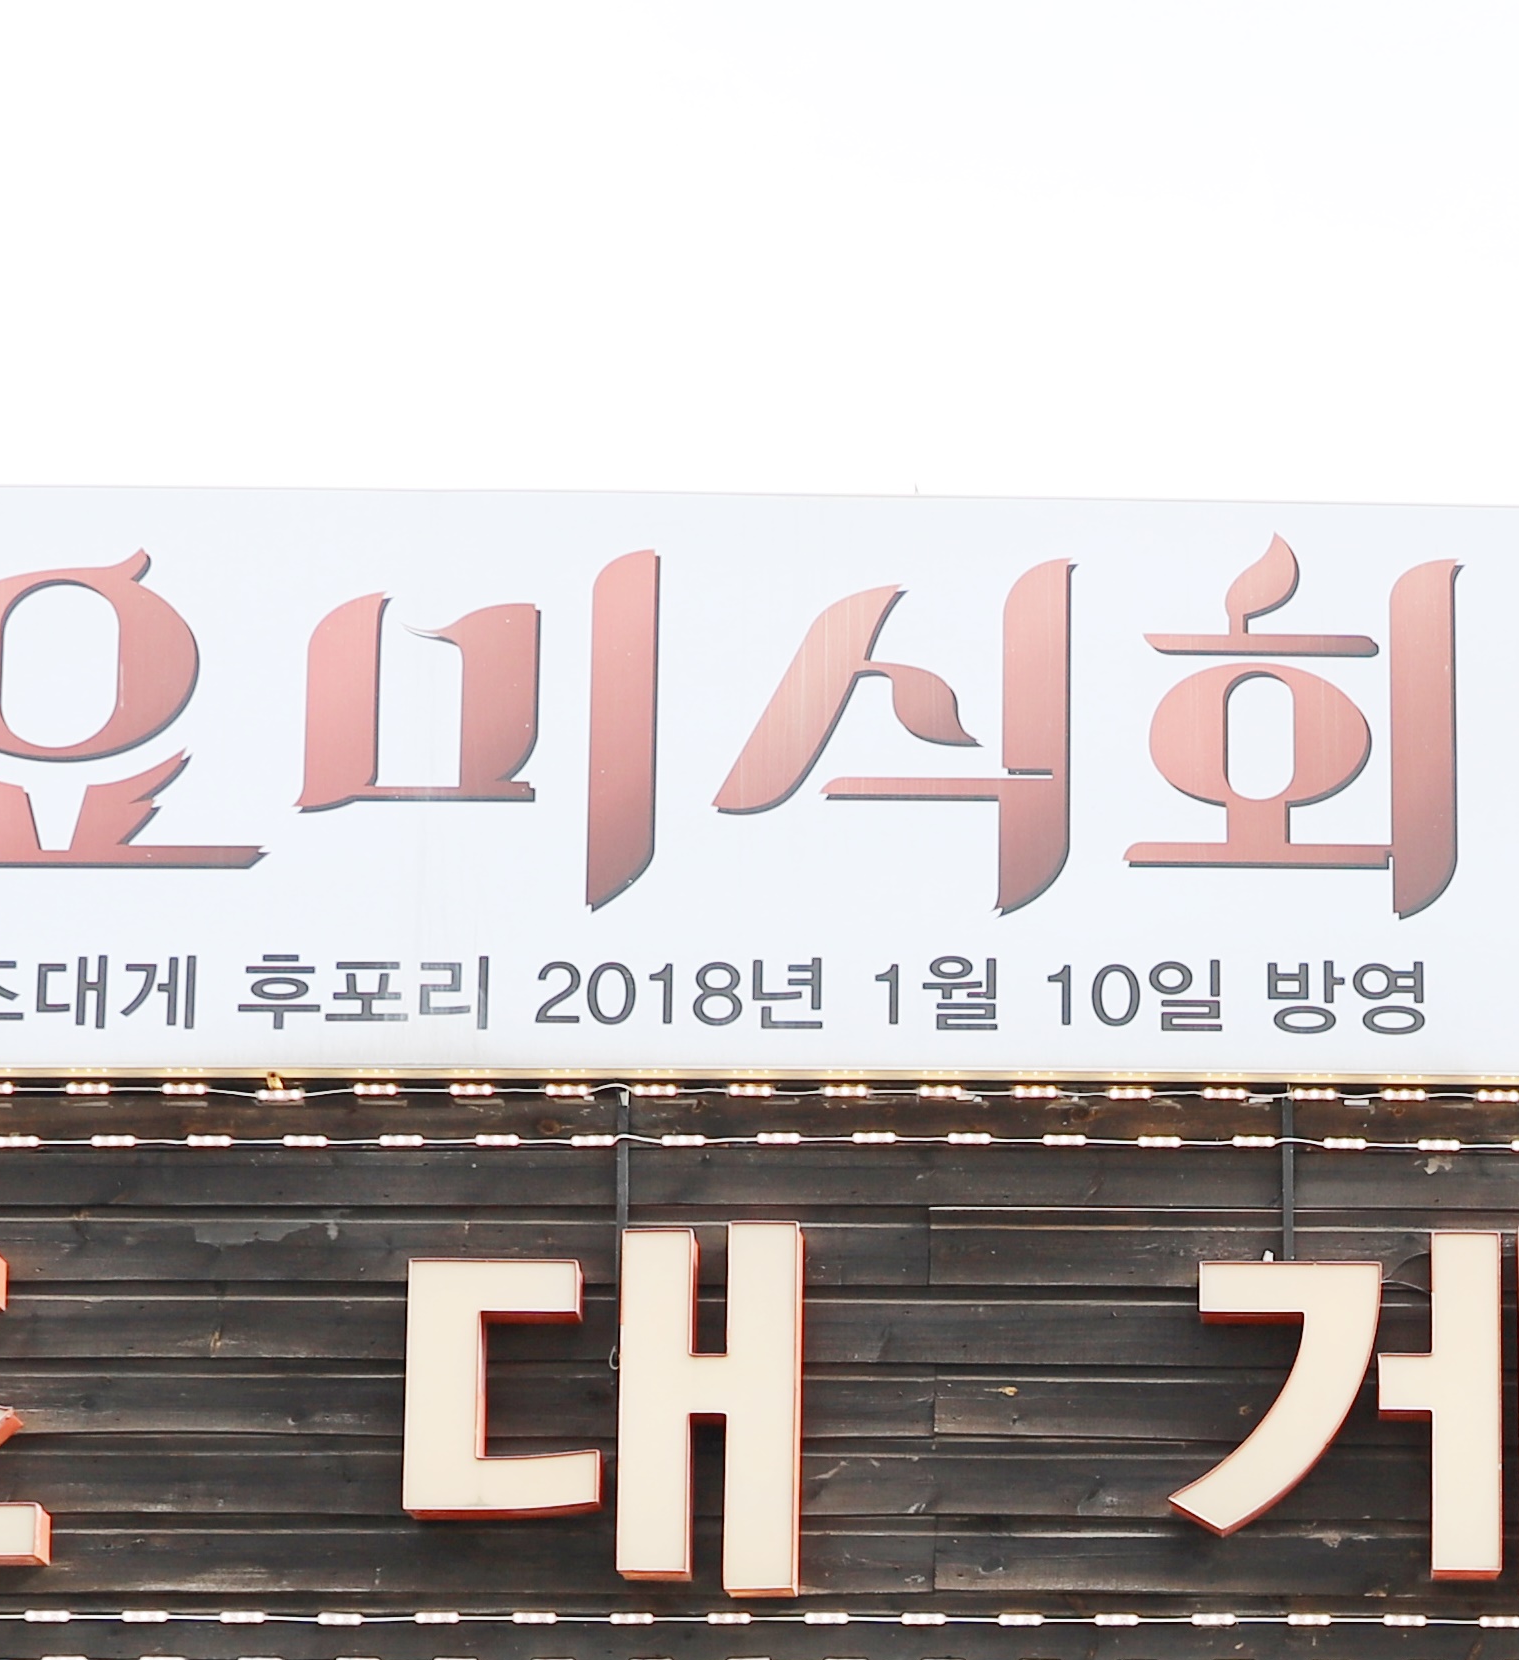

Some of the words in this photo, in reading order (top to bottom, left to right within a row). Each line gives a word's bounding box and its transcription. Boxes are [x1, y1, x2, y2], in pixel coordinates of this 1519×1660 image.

[237, 951, 491, 1031] 후포리
[534, 955, 824, 1030] 2018년
[875, 955, 999, 1030] 1월
[1047, 956, 1223, 1030] 10일
[1267, 957, 1428, 1033] 방영
